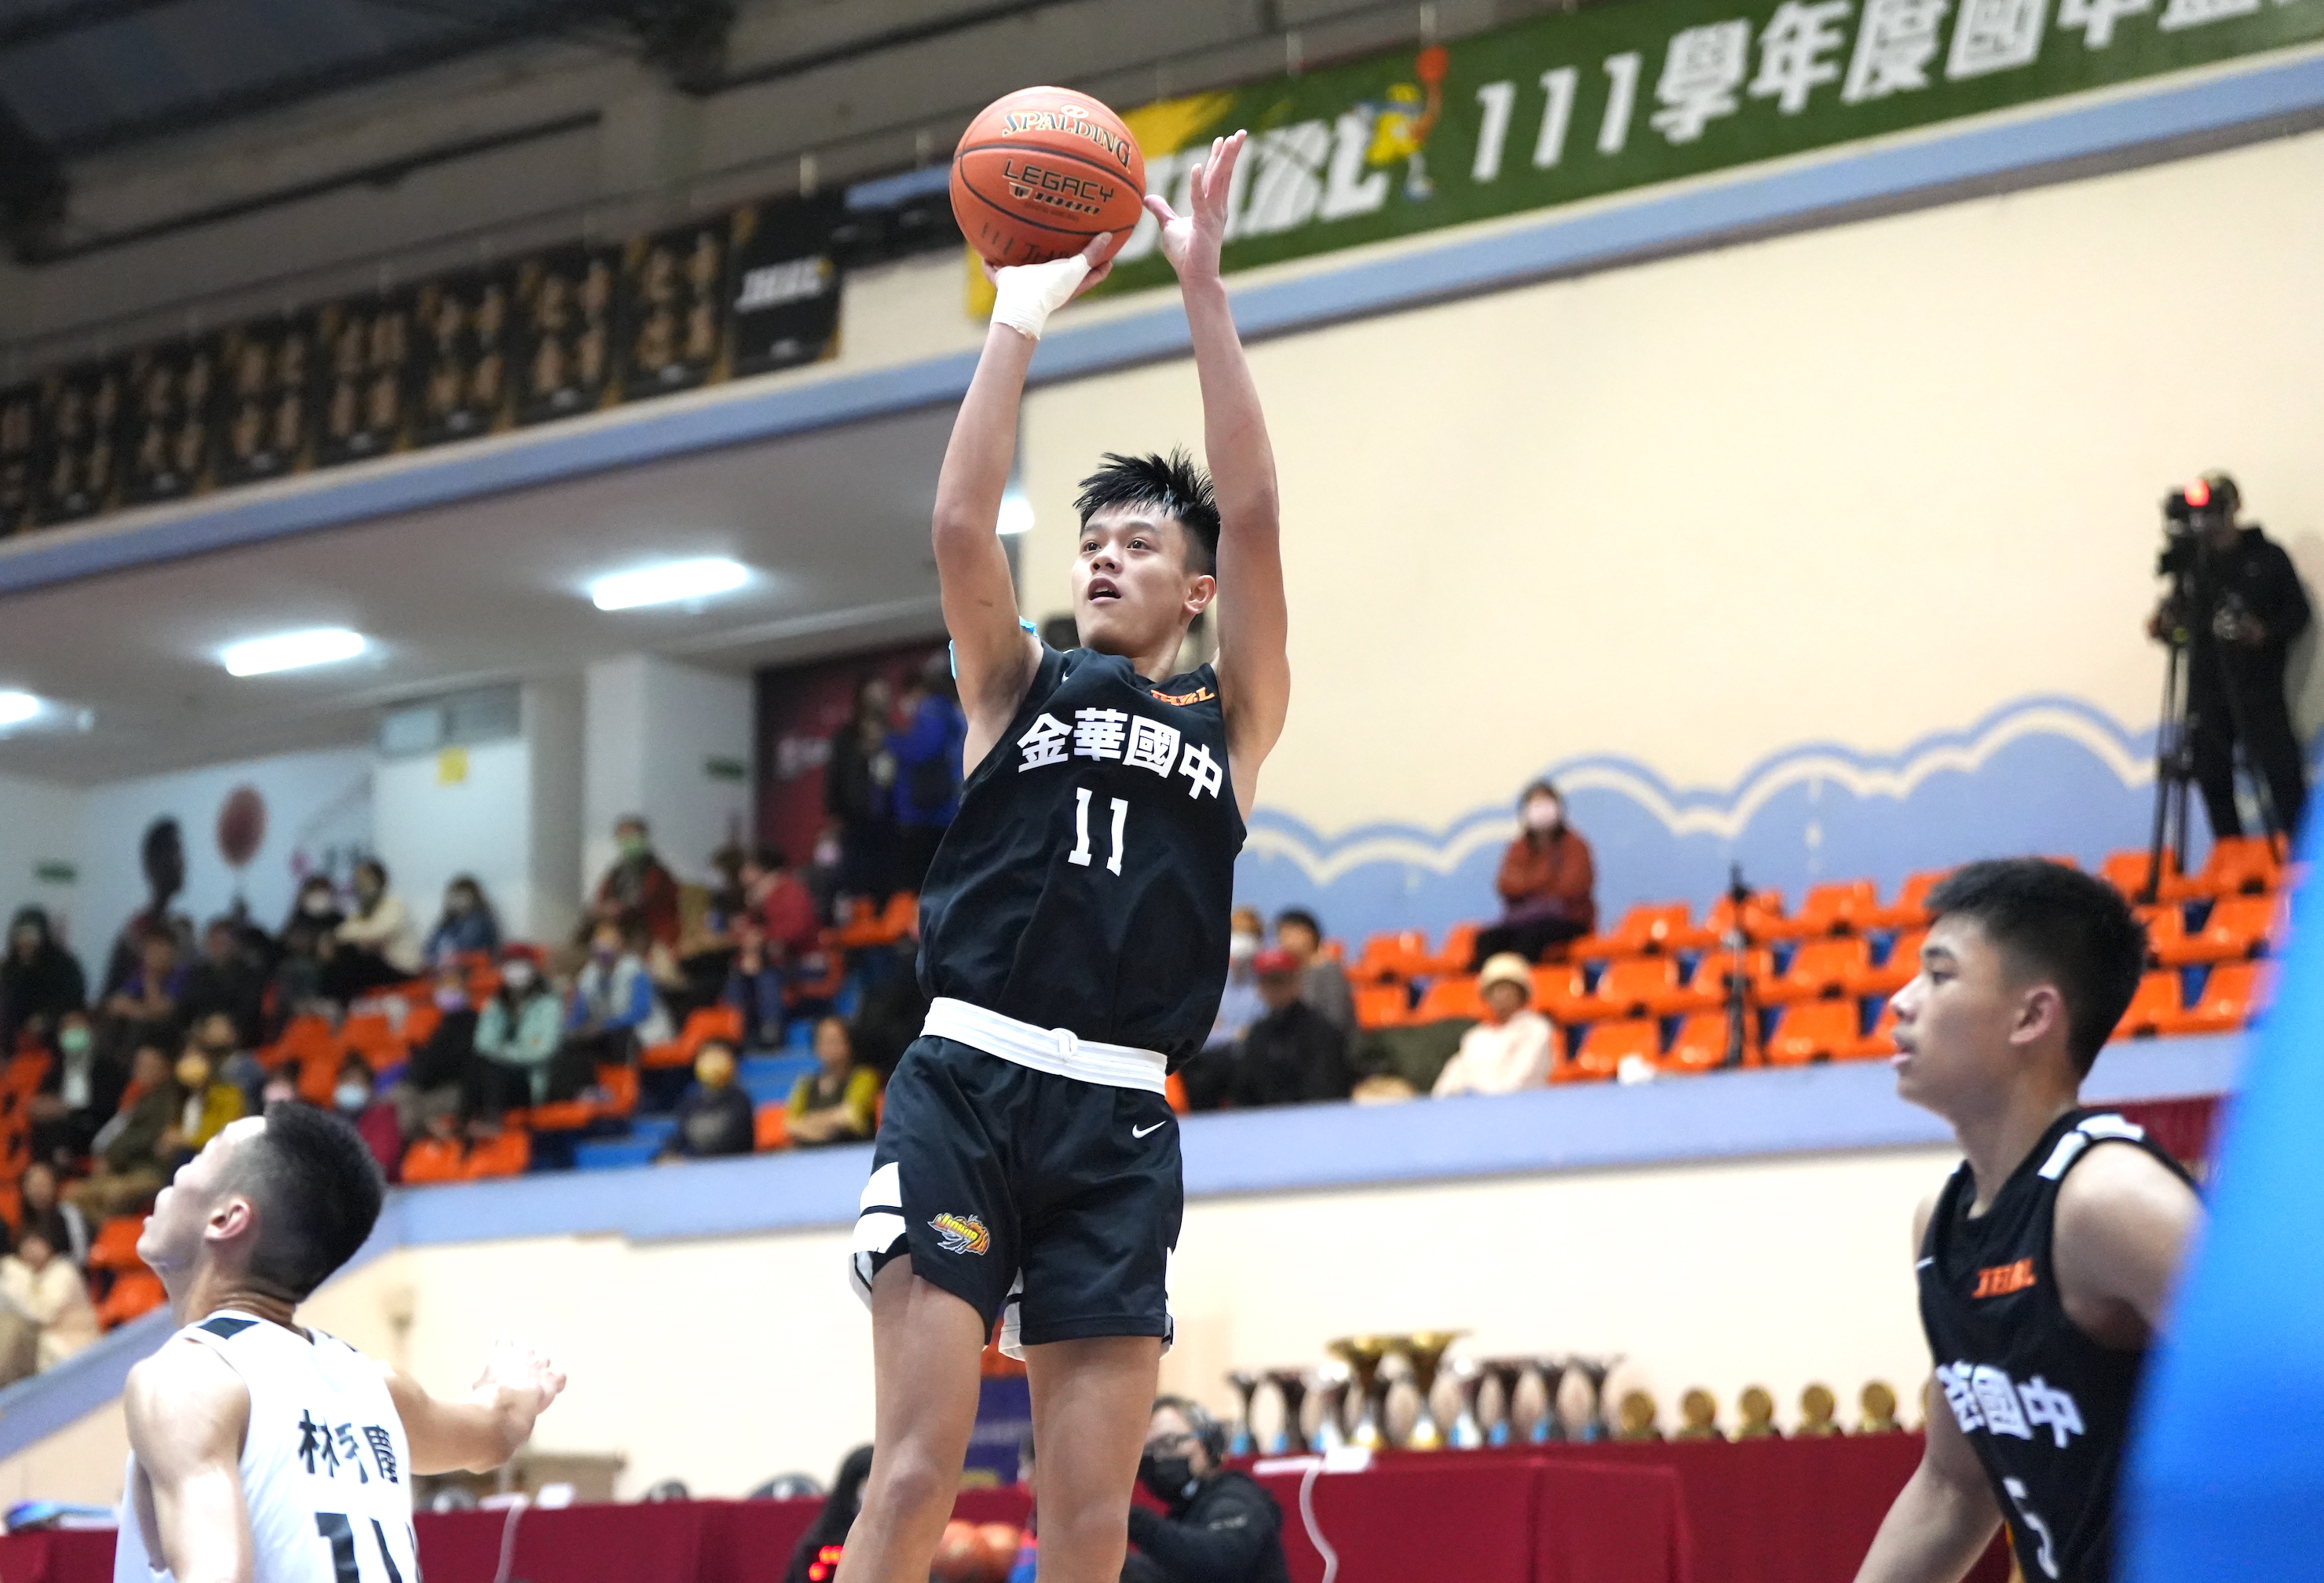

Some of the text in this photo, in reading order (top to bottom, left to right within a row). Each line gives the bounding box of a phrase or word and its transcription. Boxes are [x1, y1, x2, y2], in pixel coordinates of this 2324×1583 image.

[1002, 111, 1131, 174] SPALDING
[1002, 159, 1114, 203] LEGACY
[1016, 707, 1223, 800] 金華國中
[1068, 787, 1129, 877] 11
